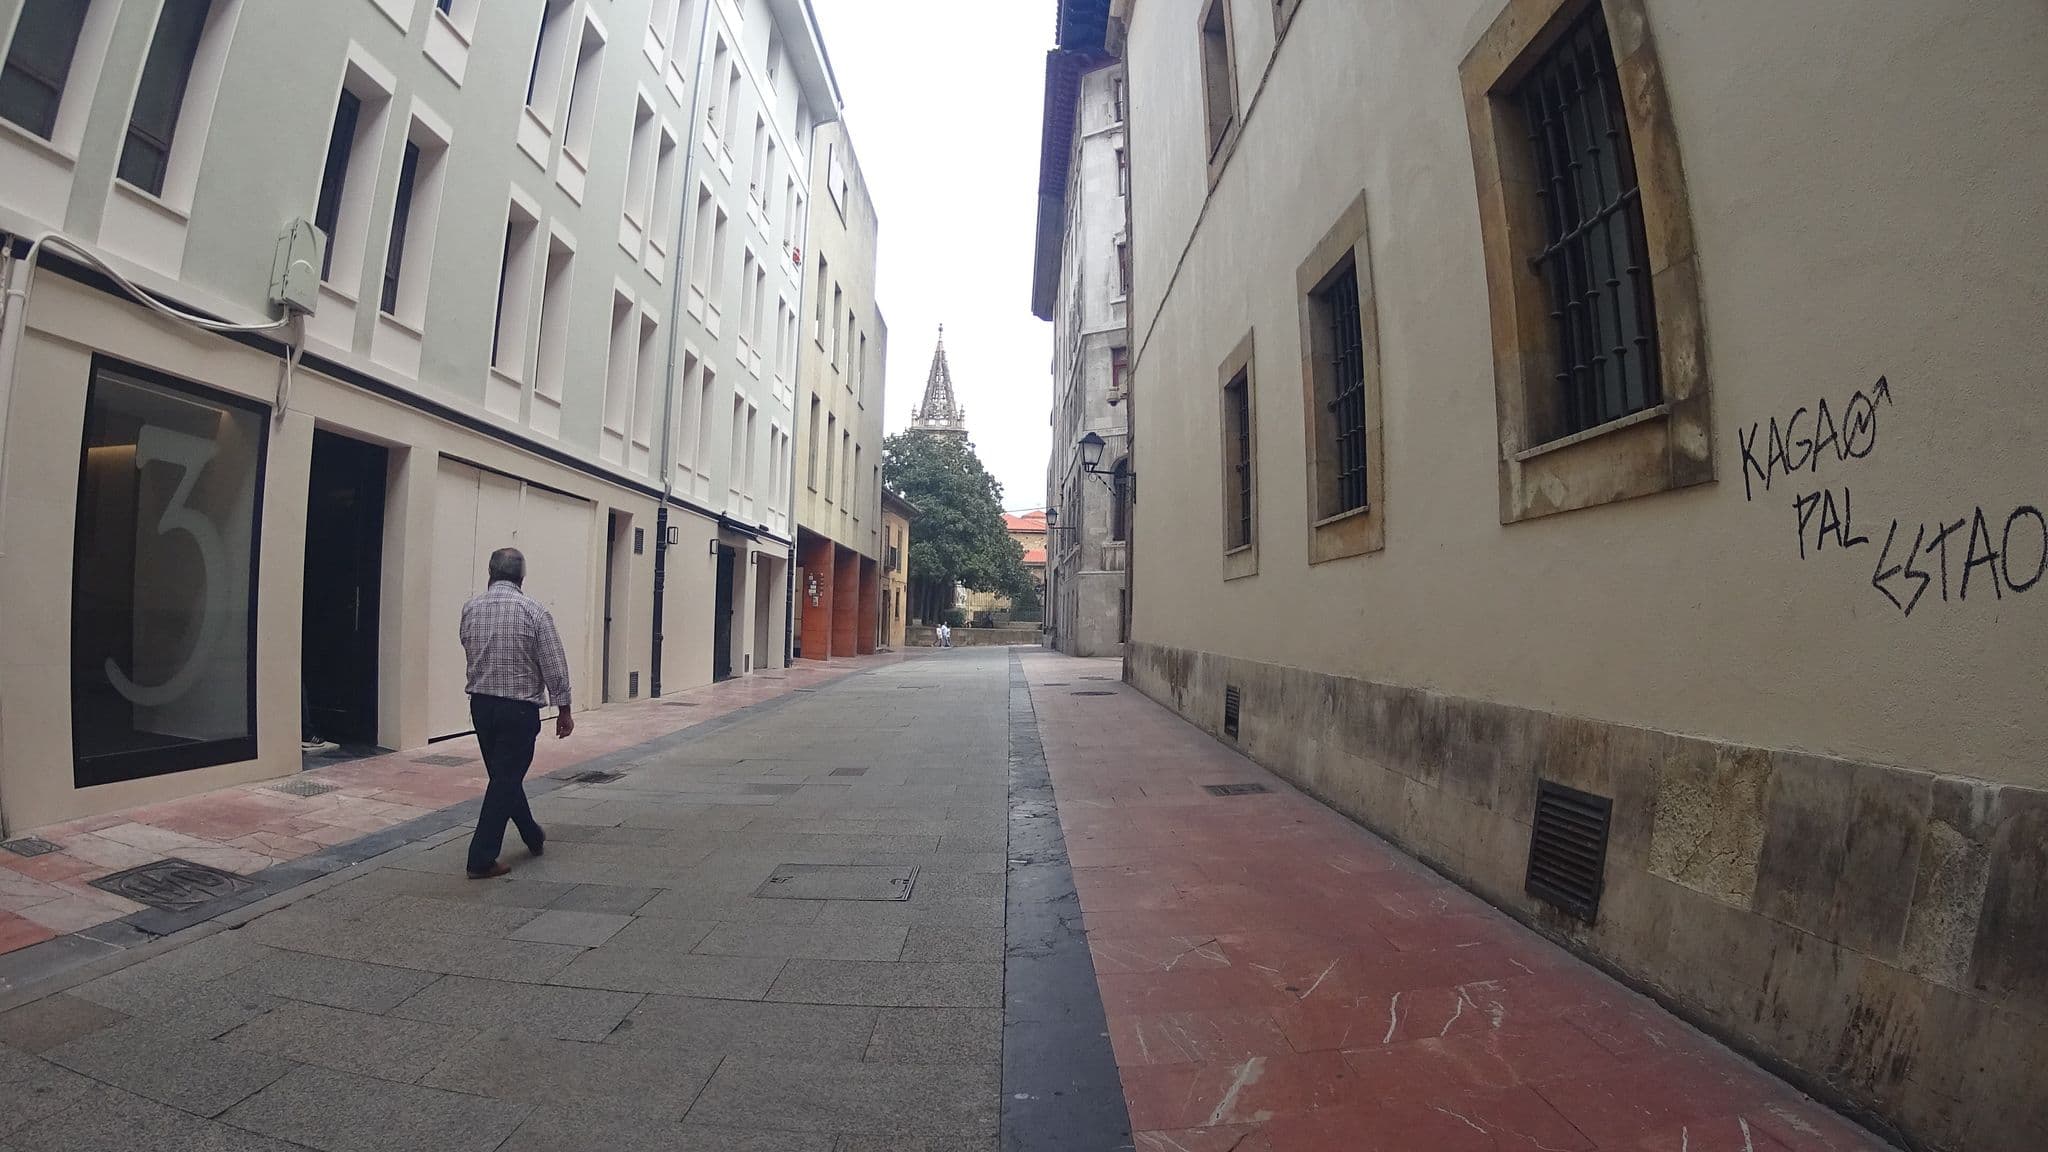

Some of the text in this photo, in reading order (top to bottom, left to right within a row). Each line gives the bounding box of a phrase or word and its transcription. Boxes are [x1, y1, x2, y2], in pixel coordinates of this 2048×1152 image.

[1738, 390, 1877, 502] KAGAO
[104, 424, 231, 706] 3
[1792, 486, 1869, 561] PAL
[1872, 505, 2047, 618] ESTAO
